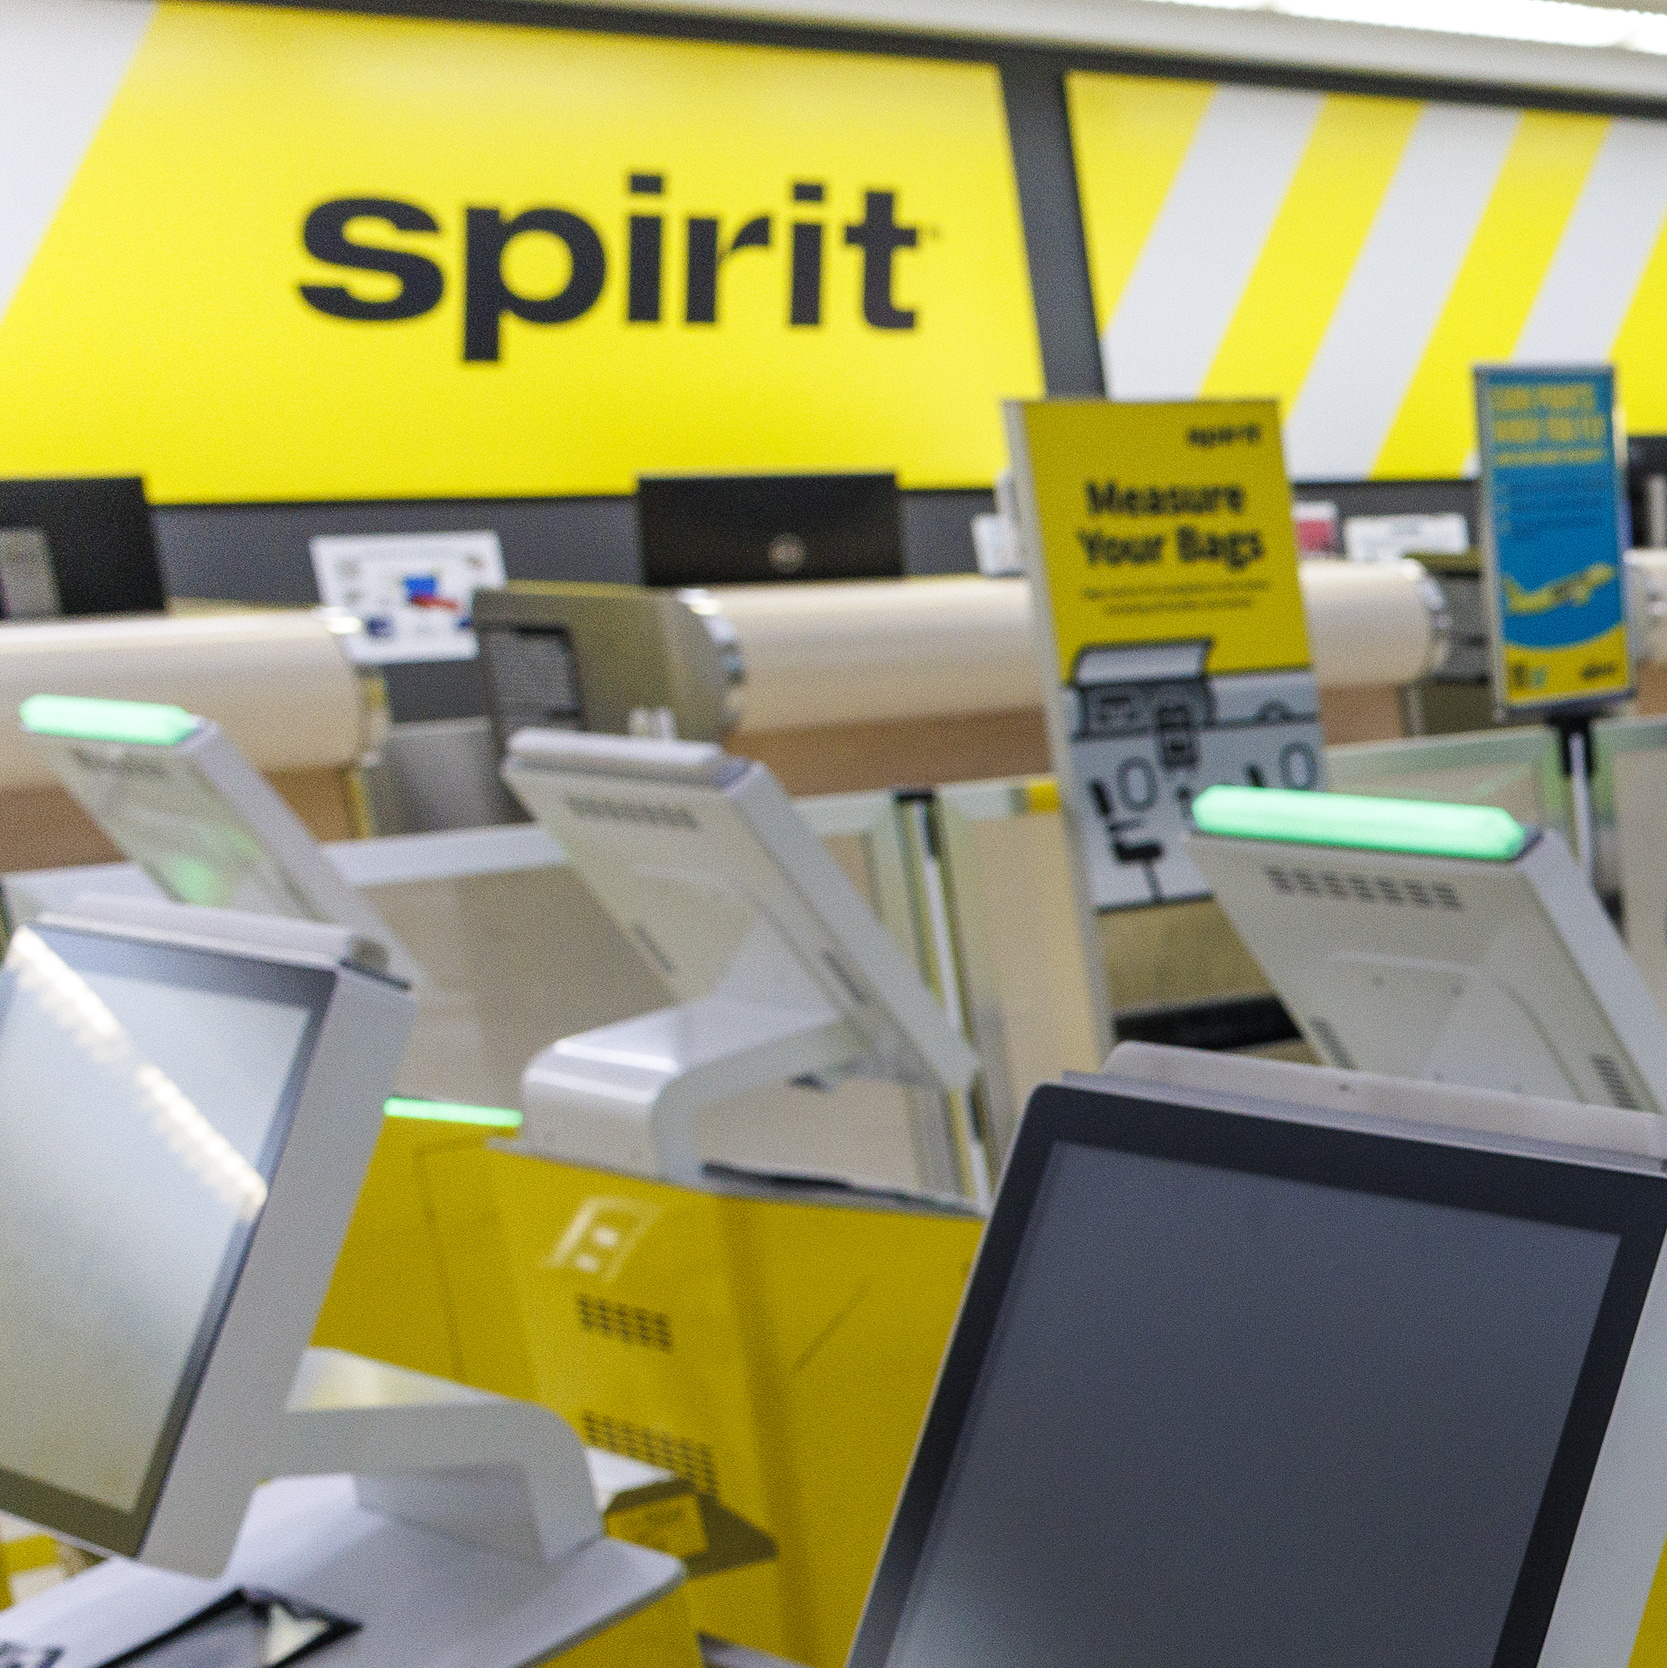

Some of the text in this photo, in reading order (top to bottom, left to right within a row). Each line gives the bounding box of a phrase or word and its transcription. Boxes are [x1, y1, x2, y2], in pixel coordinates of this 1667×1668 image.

[297, 172, 919, 363] spirit
[1085, 479, 1246, 518] Measure
[1076, 525, 1266, 573] Your Bags
